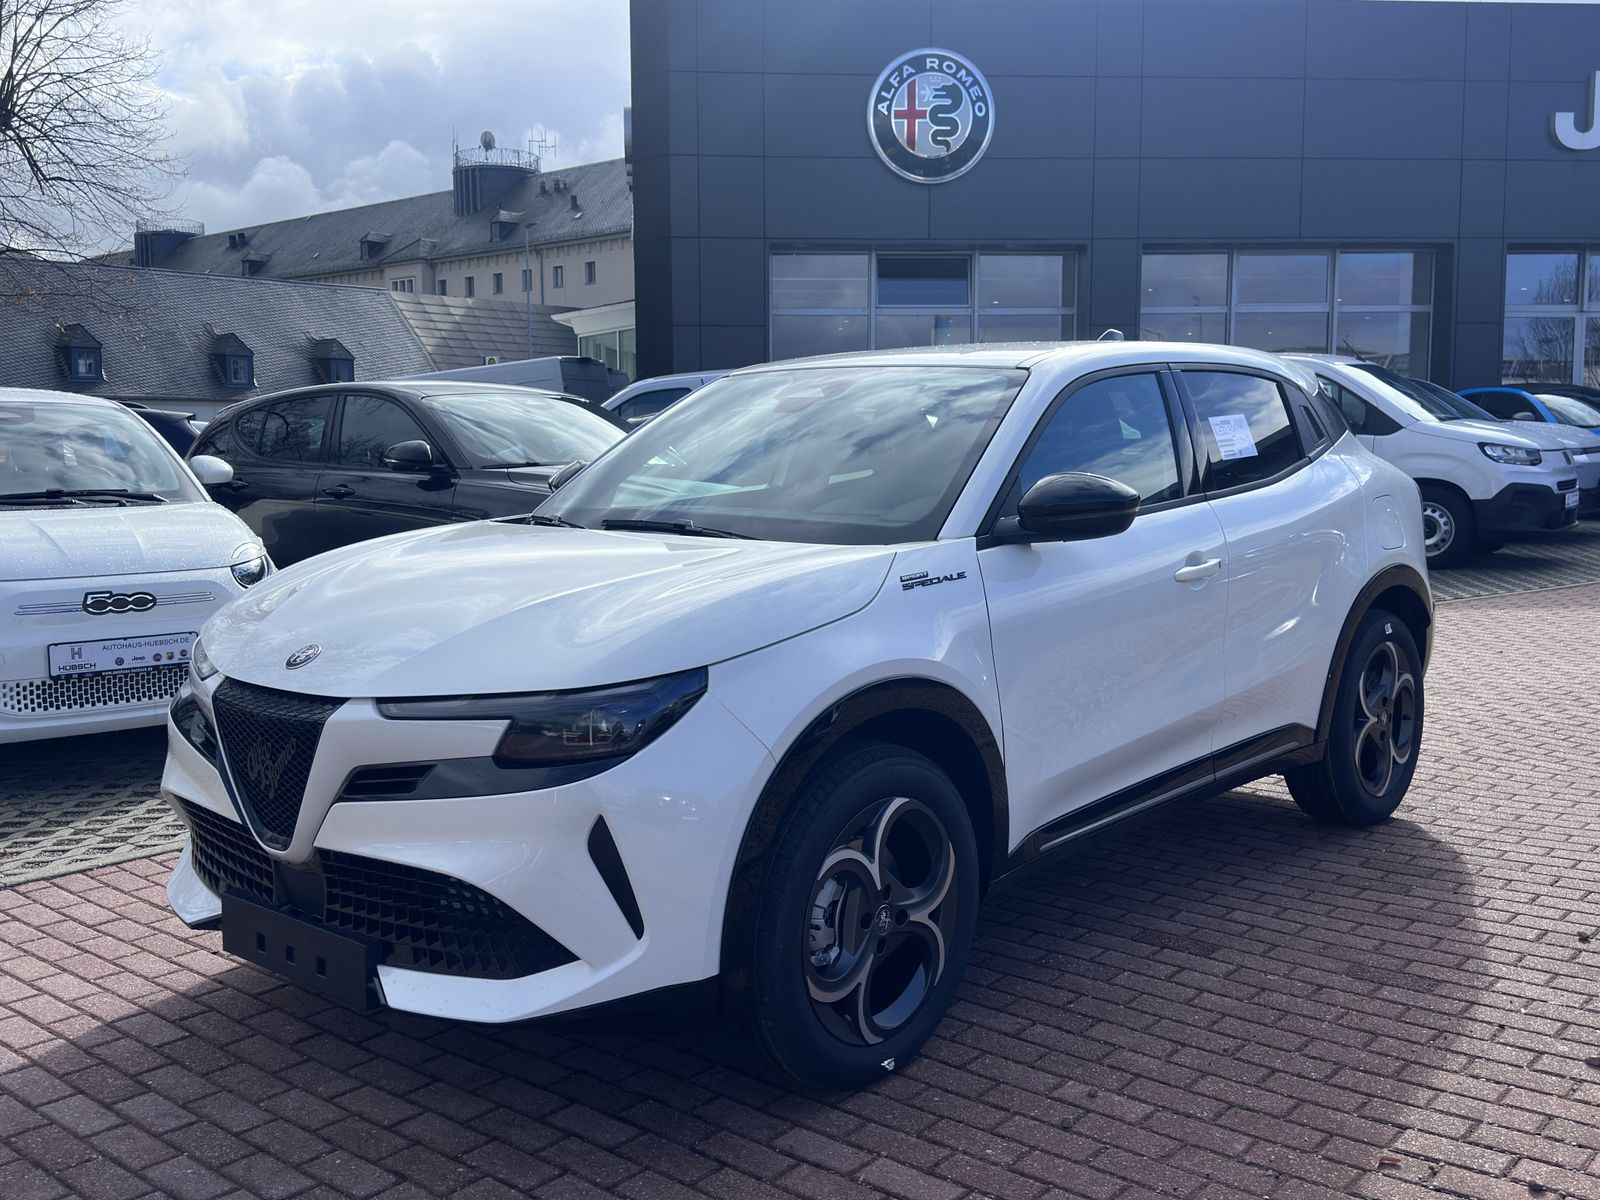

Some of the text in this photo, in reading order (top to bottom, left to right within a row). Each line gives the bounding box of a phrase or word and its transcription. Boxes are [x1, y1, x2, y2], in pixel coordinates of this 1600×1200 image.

[877, 58, 986, 117] ALFA ROMEO
[1554, 70, 1600, 150] J
[82, 590, 157, 615] 500
[102, 637, 190, 651] AUTOHAUS-HUEBSCH.DE
